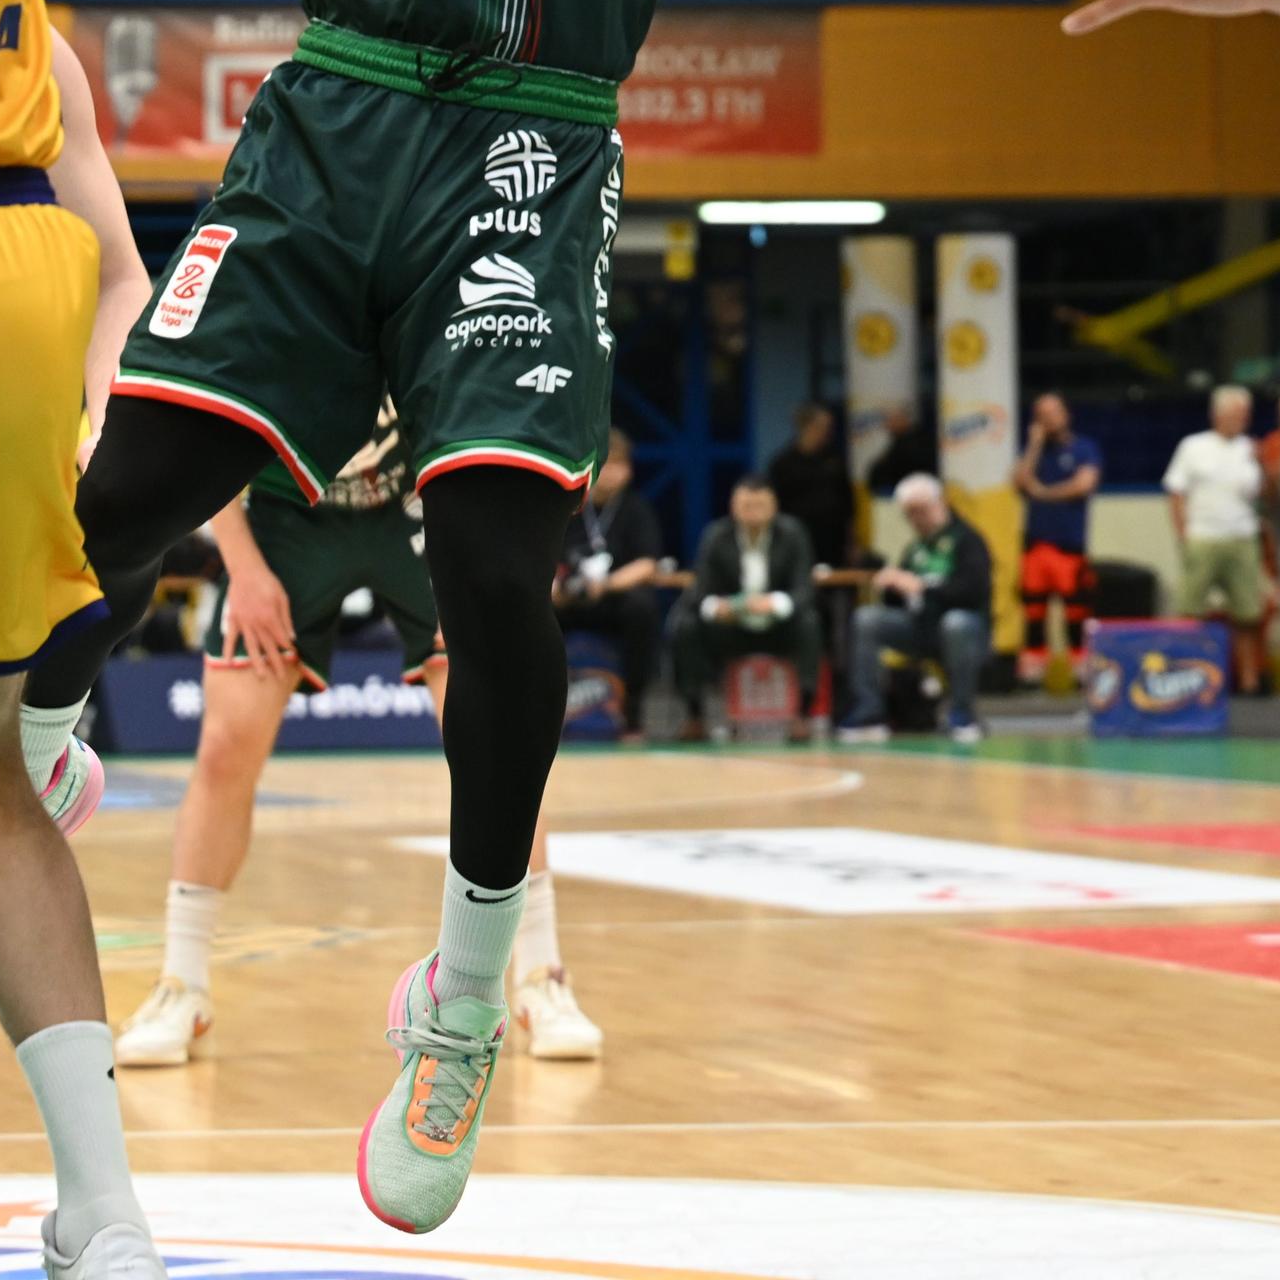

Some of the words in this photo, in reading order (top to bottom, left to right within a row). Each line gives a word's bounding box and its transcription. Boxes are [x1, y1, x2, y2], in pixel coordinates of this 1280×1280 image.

[469, 206, 543, 237] plus
[444, 311, 552, 340] aquapark
[515, 363, 573, 394] 4F
